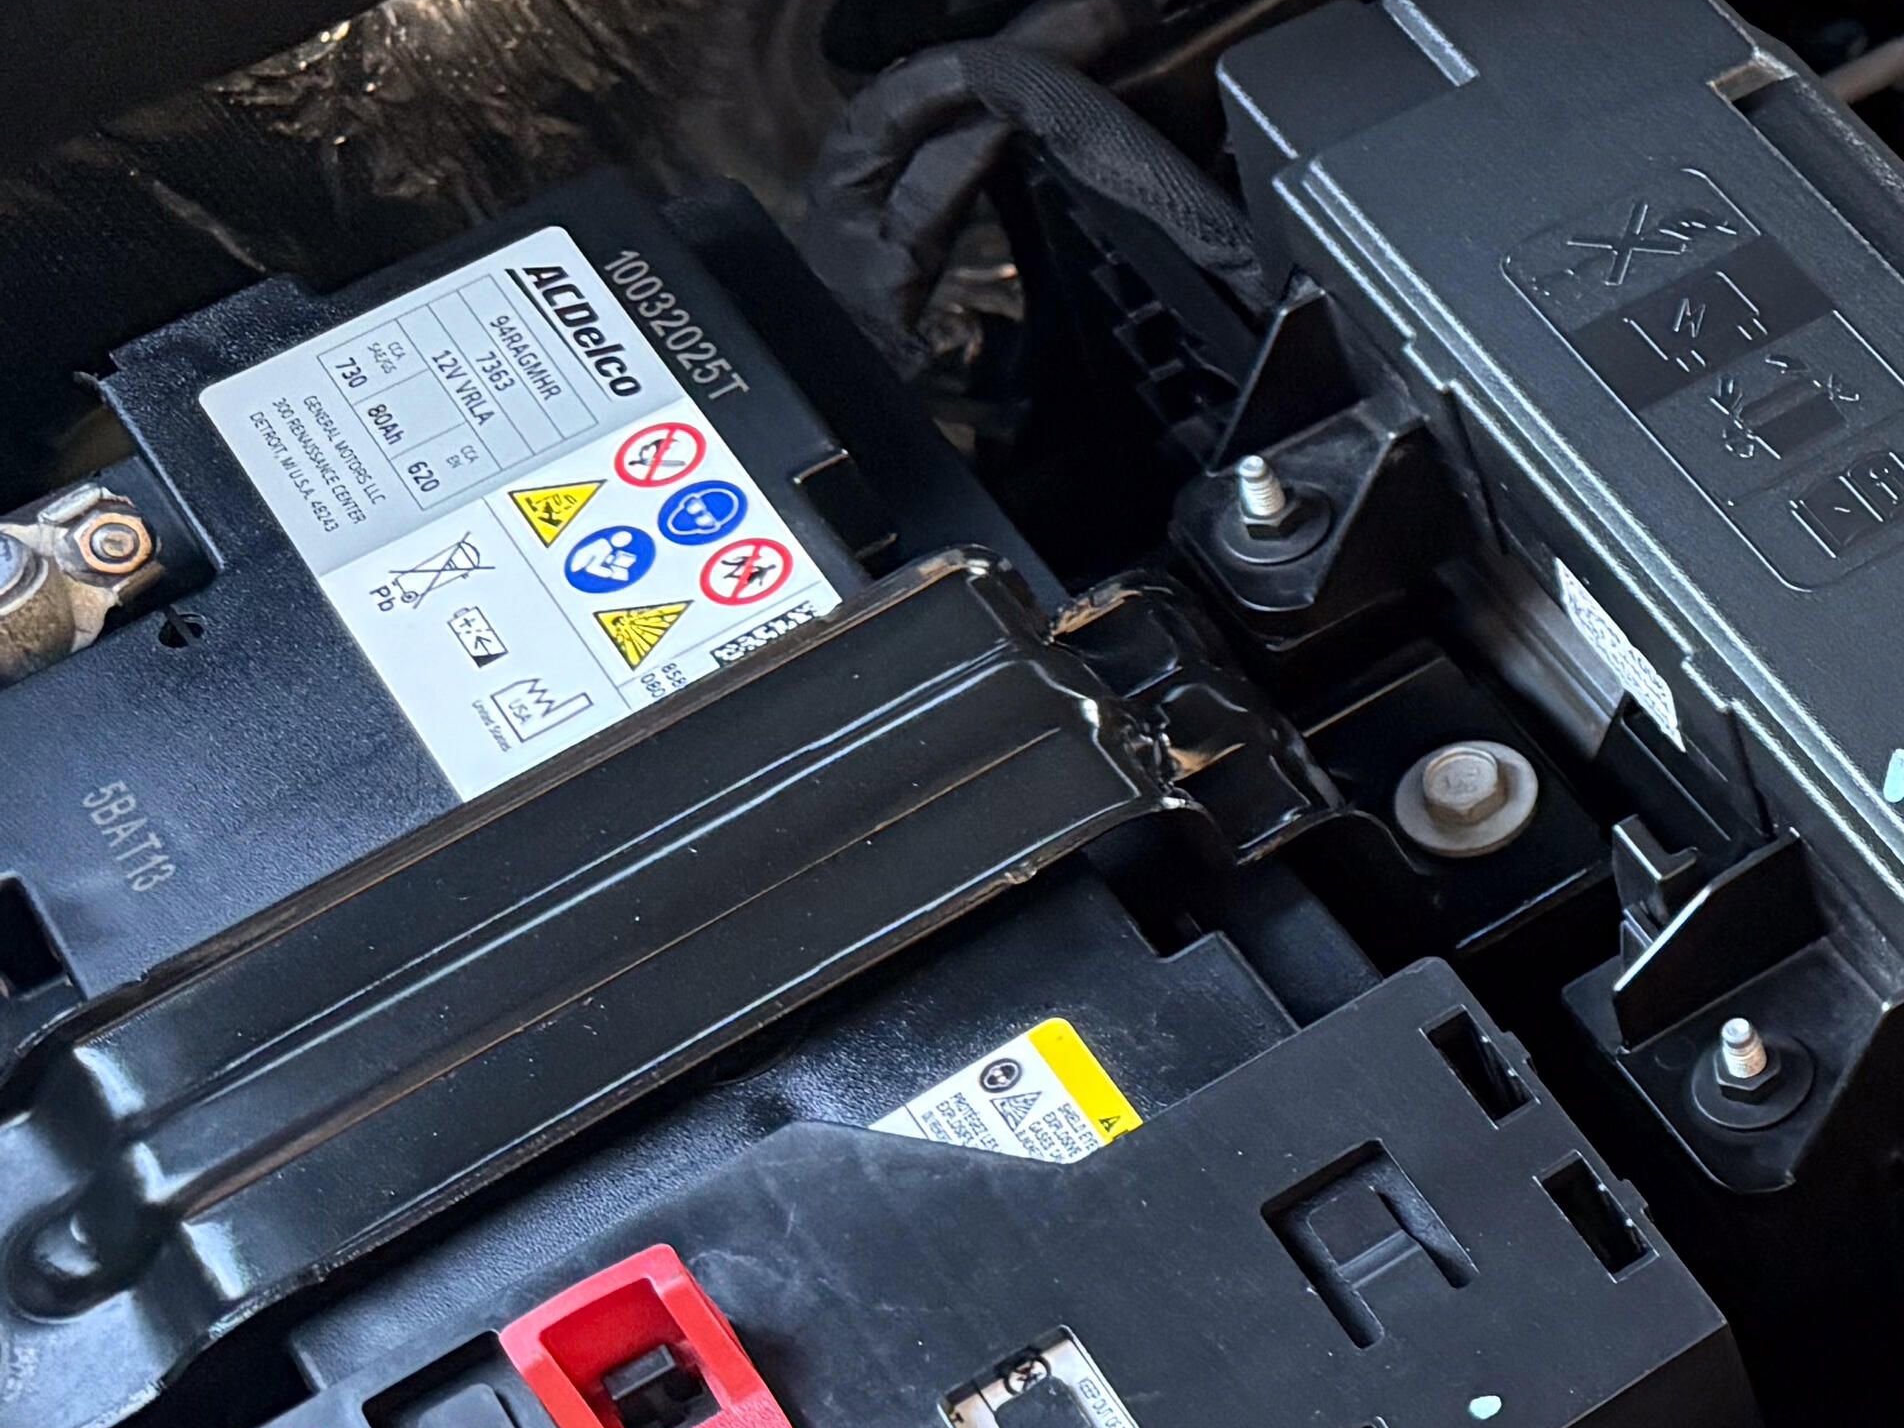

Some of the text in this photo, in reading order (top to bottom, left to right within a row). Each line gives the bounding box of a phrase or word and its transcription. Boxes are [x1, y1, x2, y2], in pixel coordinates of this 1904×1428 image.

[490, 316, 561, 400] 94RAGMHR
[524, 265, 643, 400] ACDelco
[605, 251, 749, 399] 10032025T
[336, 357, 367, 388] 730
[432, 350, 494, 426] 12V VRLA
[476, 351, 515, 391] 7363
[272, 398, 366, 524] 300 RENAISSANCE CENTER
[304, 396, 386, 504] GENERAL MOTORS LLC
[368, 404, 404, 445] 80Ah
[250, 412, 288, 458] DETROIT,
[311, 501, 339, 532] 48243
[408, 462, 440, 492] 620
[370, 585, 395, 611] Pb
[508, 699, 532, 724] USA
[83, 780, 176, 891] 5BAT13
